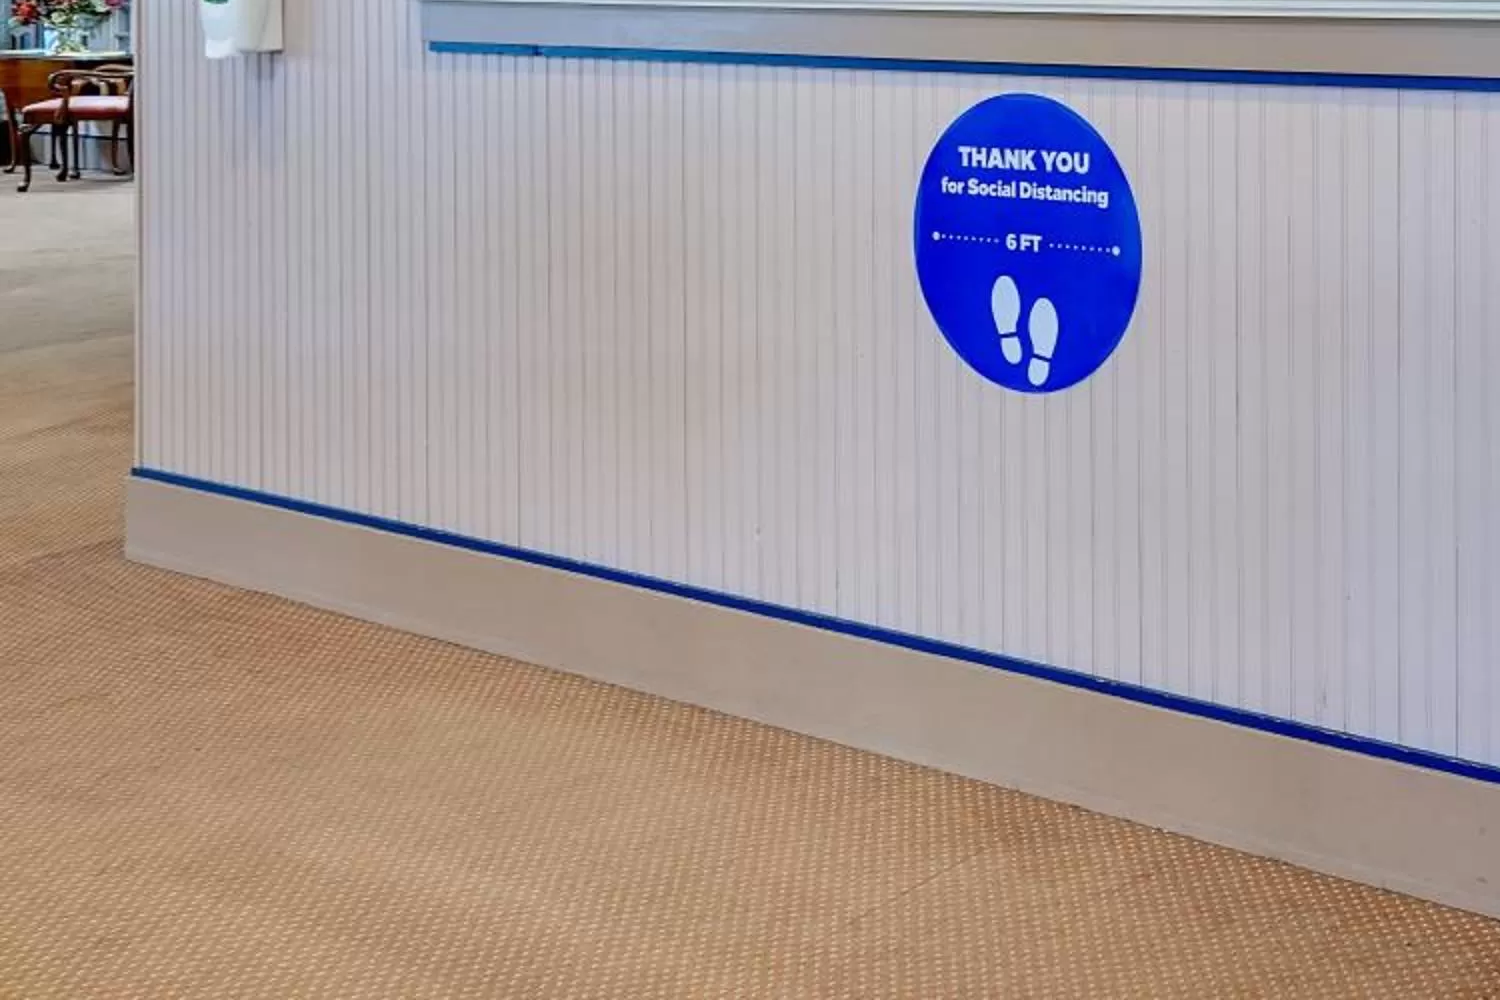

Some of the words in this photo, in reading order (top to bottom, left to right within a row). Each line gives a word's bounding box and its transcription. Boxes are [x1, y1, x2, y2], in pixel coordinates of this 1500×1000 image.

[958, 146, 1037, 172] THANK
[1041, 151, 1090, 174] YOU
[941, 177, 964, 195] for
[968, 178, 1016, 199] Social
[1020, 182, 1109, 209] Distancing
[1005, 233, 1017, 251] 6
[1020, 235, 1042, 253] FT
